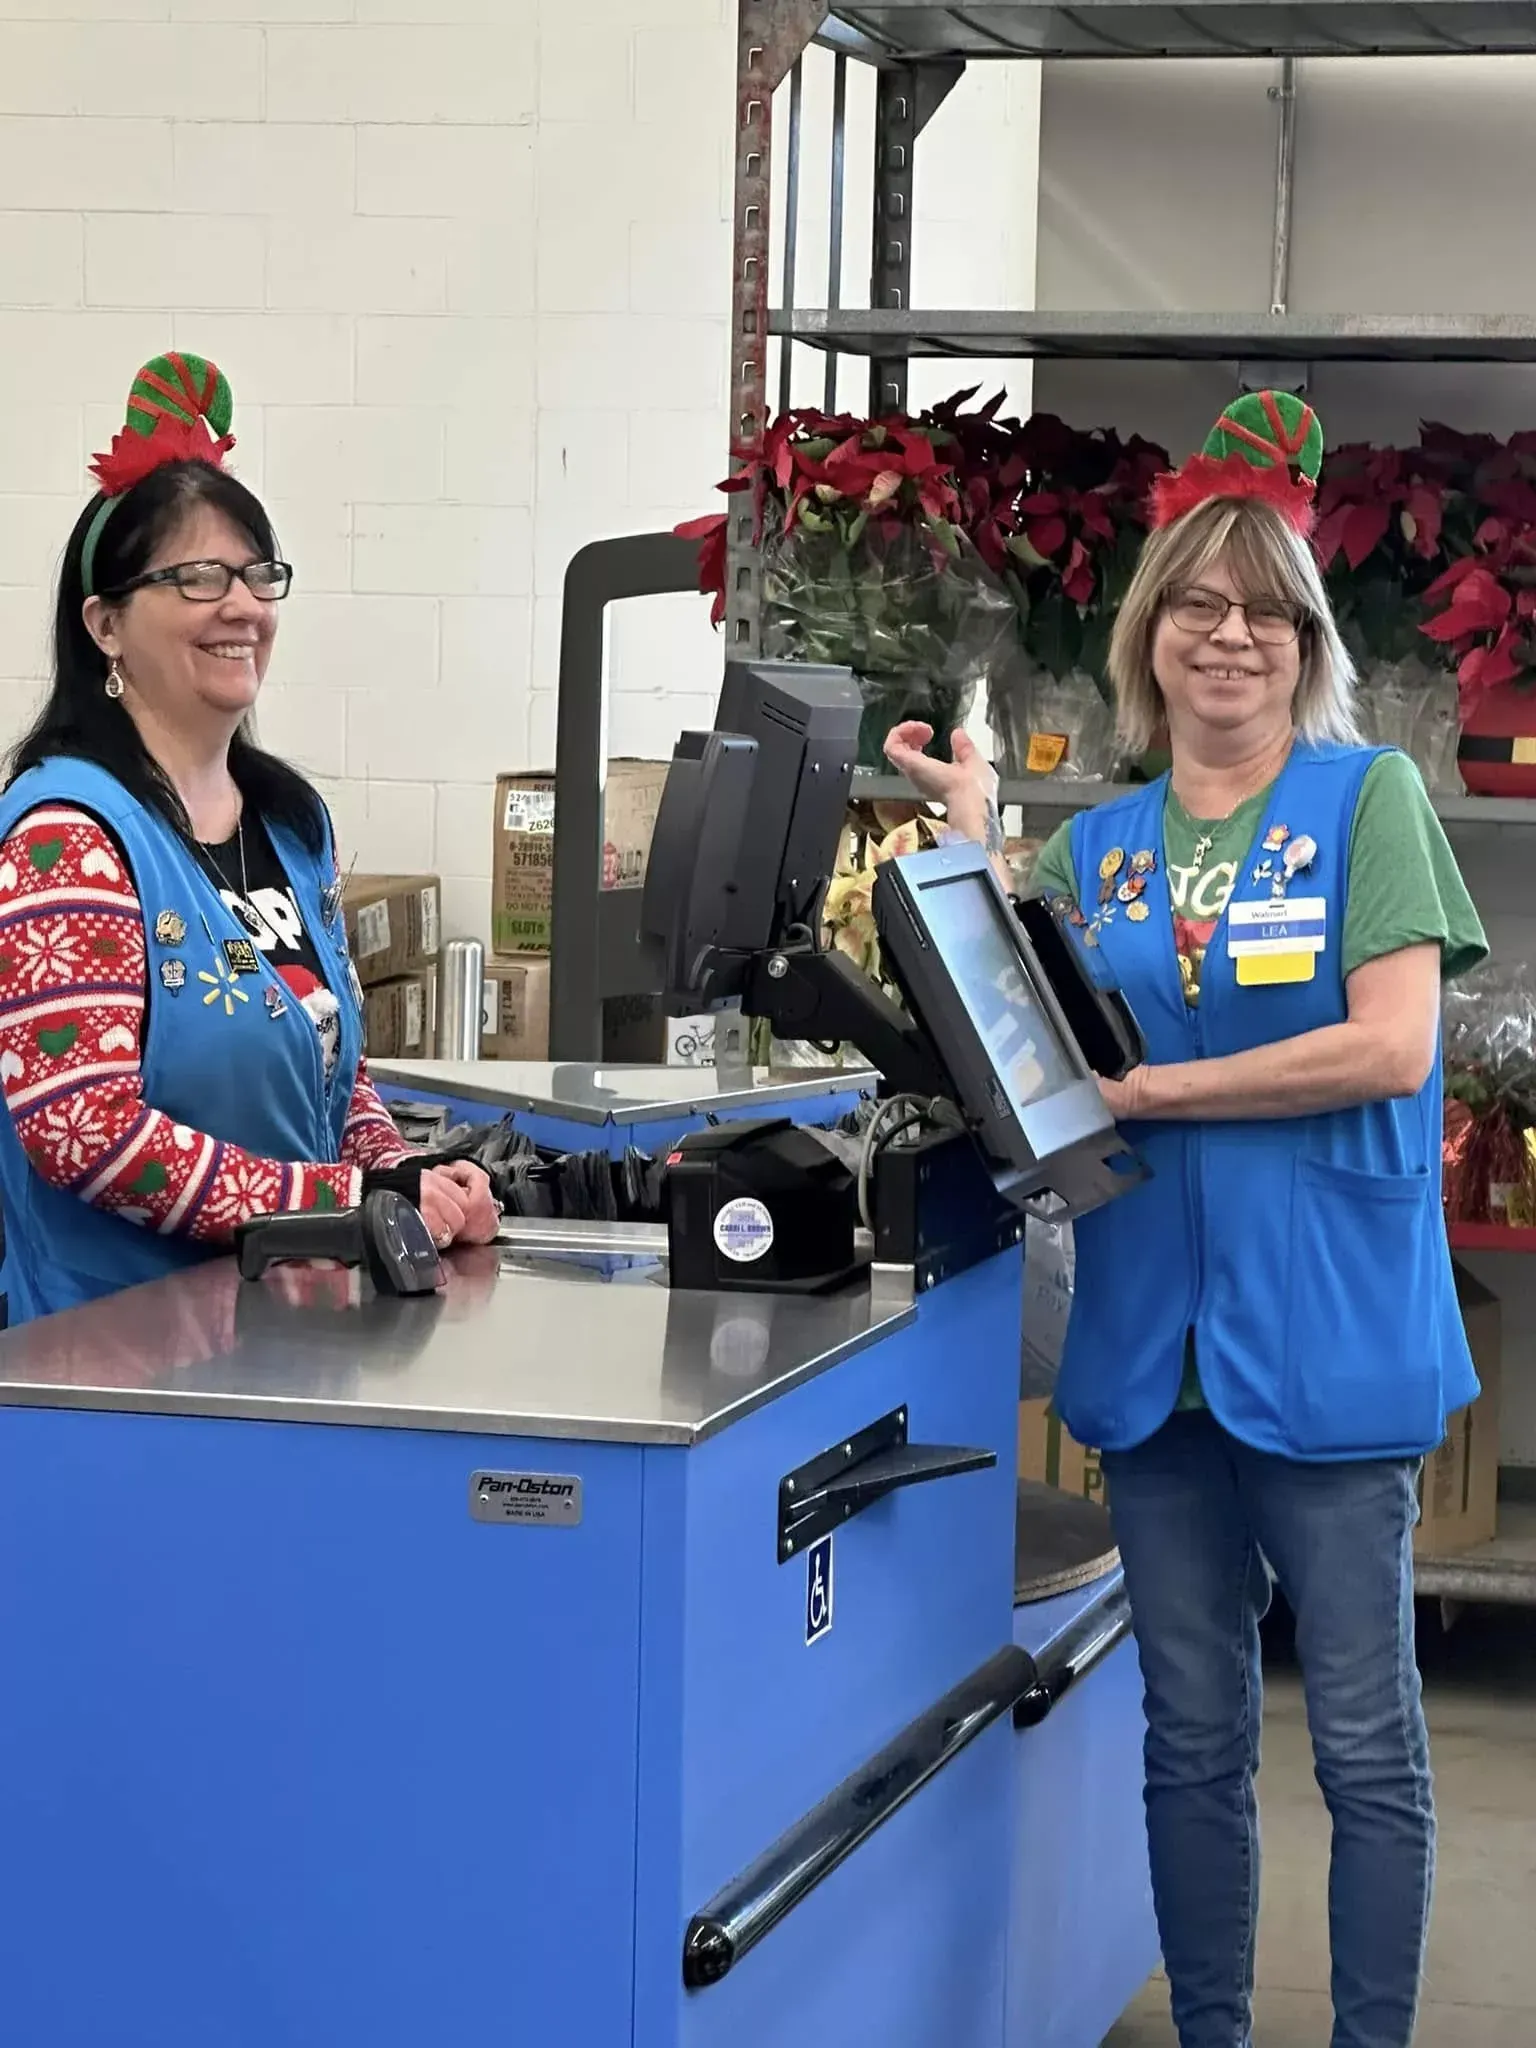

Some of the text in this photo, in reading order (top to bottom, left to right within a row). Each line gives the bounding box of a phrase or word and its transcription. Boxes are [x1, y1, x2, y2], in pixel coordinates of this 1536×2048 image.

[1251, 909, 1288, 920] Walmart
[1261, 923, 1288, 938] LEA
[478, 1476, 574, 1496] Pan-Oston
